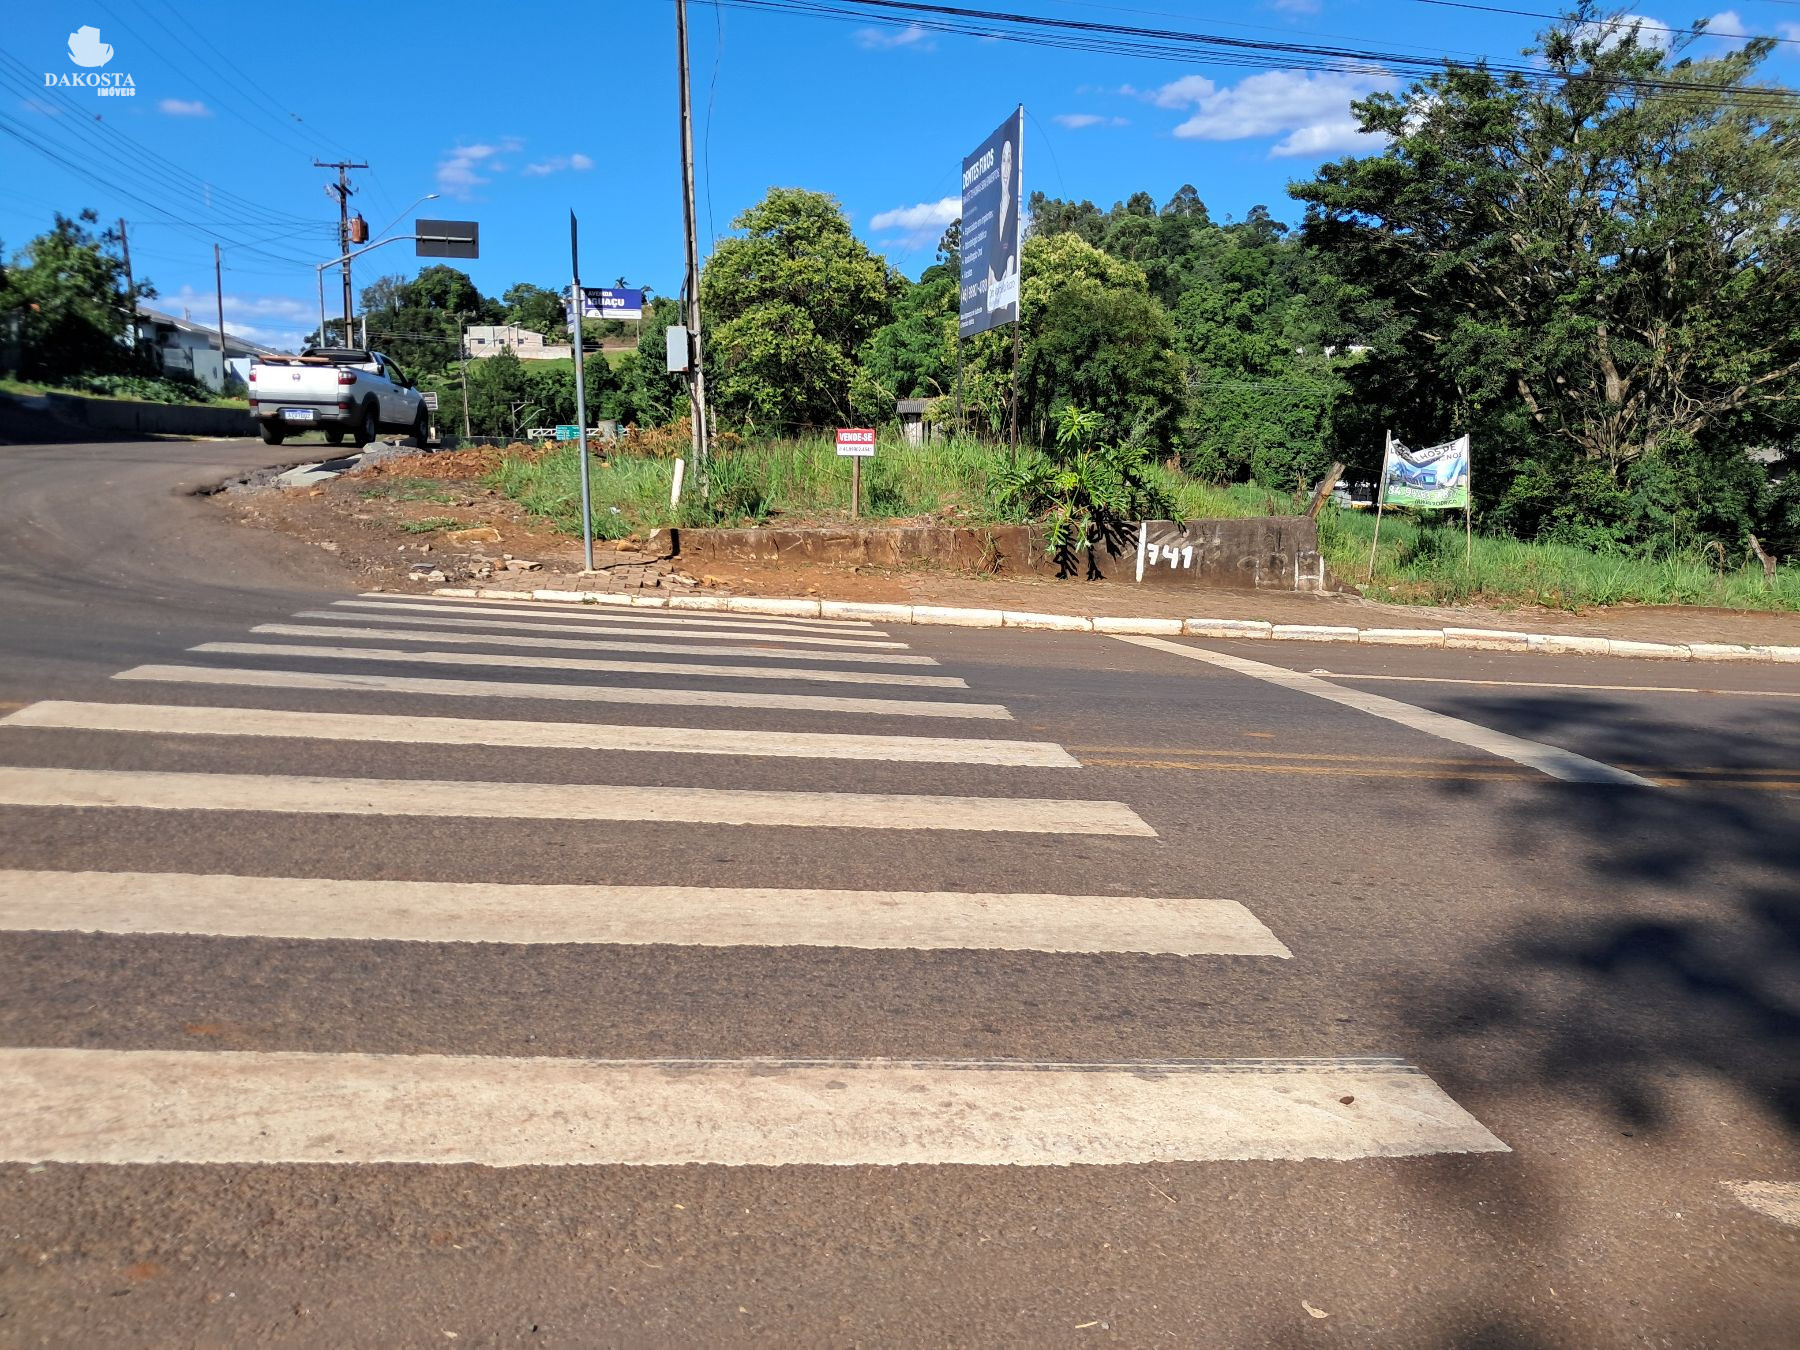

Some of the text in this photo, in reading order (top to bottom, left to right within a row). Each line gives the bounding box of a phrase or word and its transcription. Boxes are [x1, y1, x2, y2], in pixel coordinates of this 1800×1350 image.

[587, 298, 625, 308] IGUAÇU
[839, 432, 873, 442] VENDE-SE
[1146, 543, 1194, 569] 741
